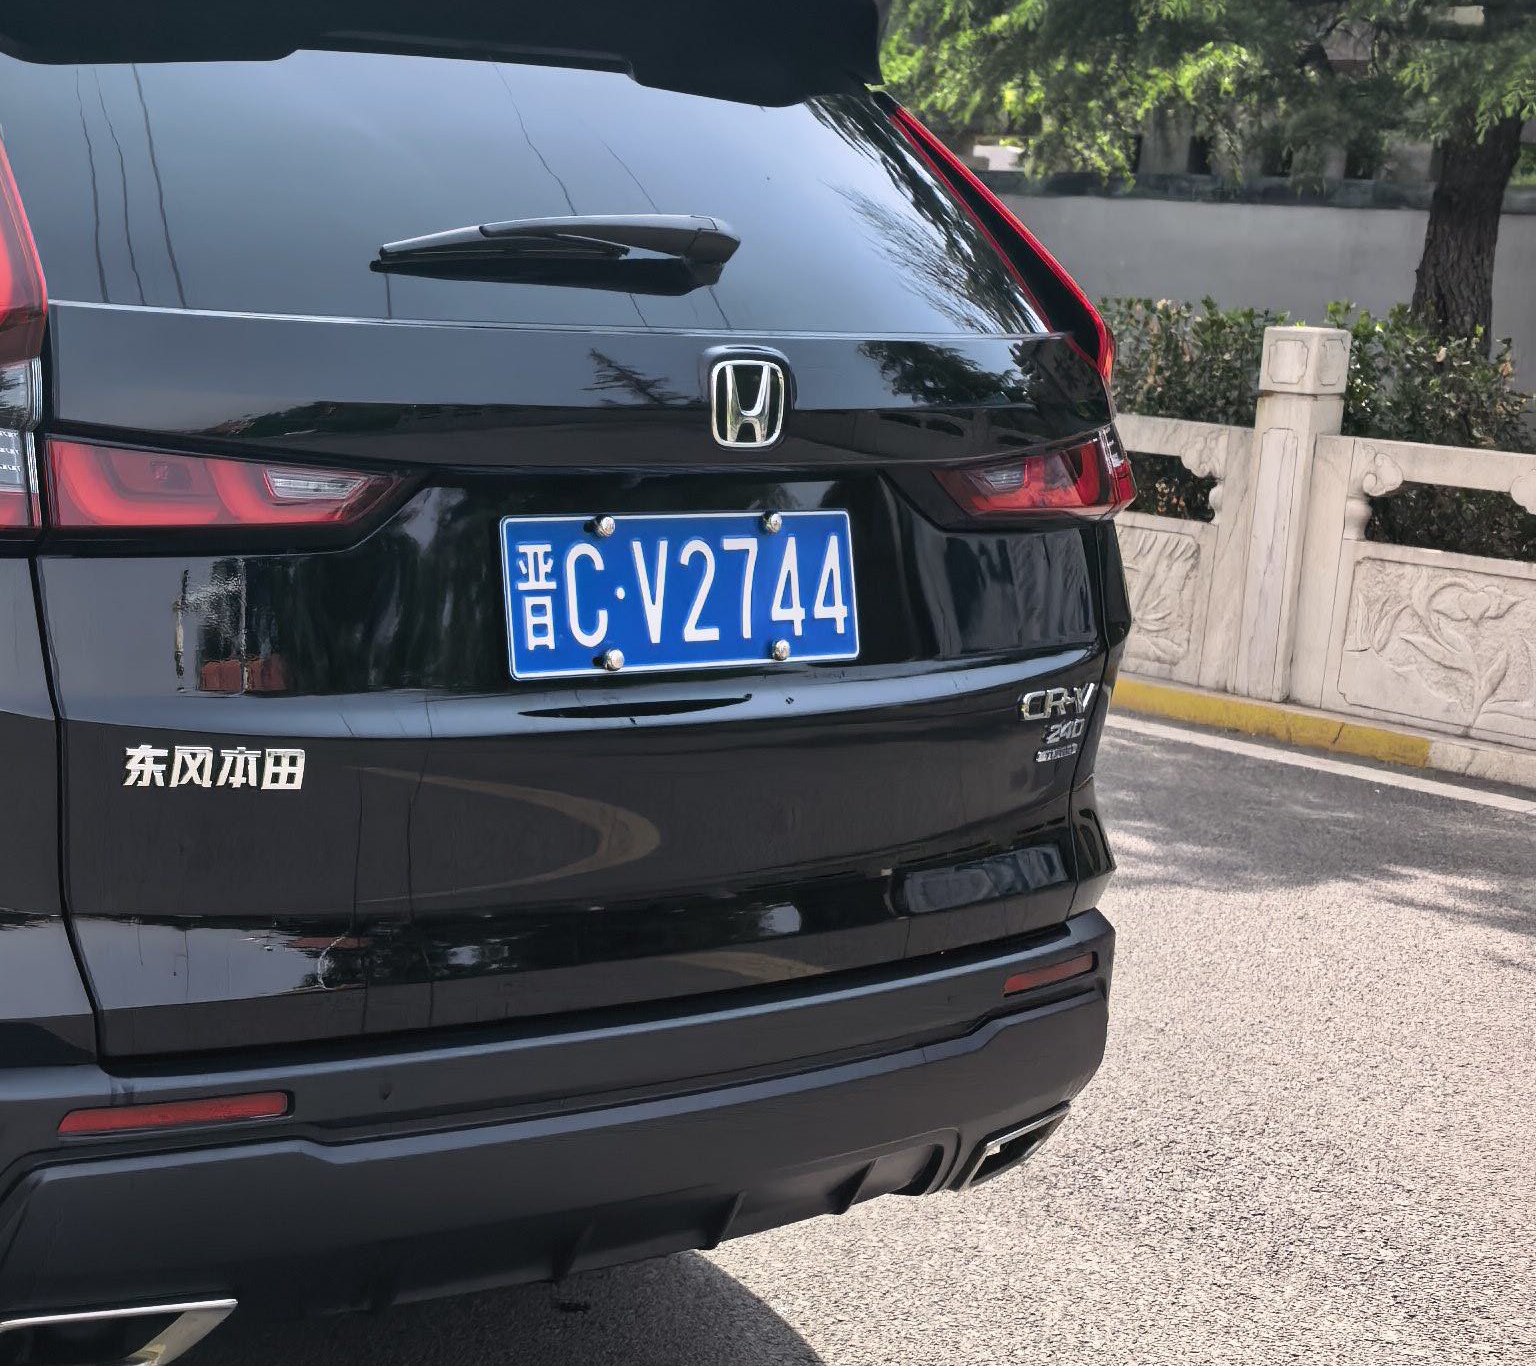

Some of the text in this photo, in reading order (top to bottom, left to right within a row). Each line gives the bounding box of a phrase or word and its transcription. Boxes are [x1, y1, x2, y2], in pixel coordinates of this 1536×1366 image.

[517, 534, 849, 651] 晋C·V2744
[1020, 682, 1095, 721] CR-V
[1046, 718, 1085, 744] 240
[122, 744, 306, 790] 东风本田
